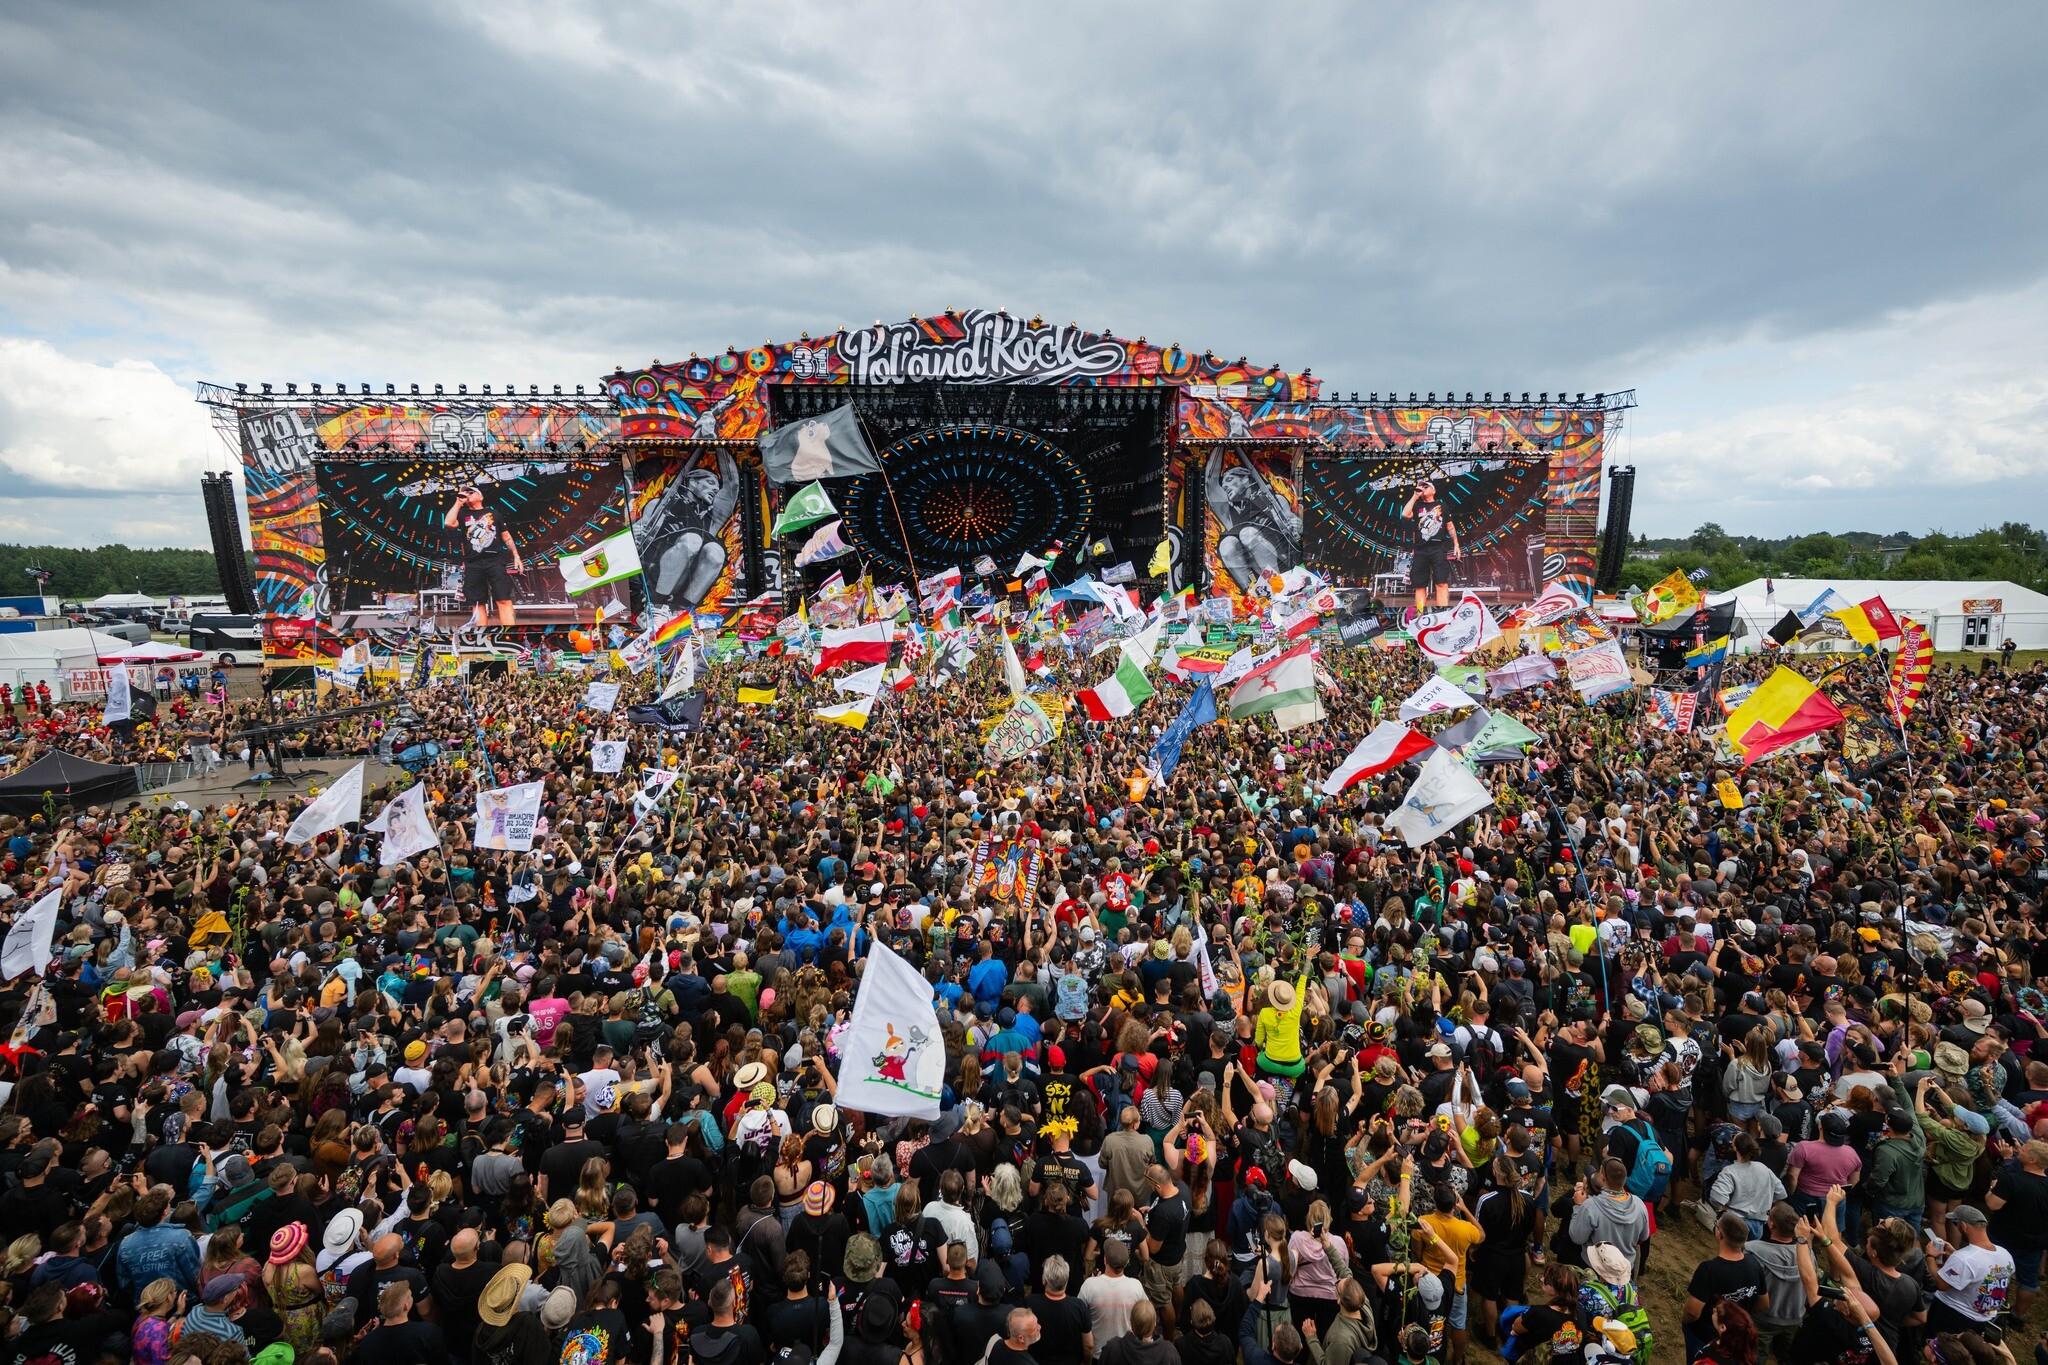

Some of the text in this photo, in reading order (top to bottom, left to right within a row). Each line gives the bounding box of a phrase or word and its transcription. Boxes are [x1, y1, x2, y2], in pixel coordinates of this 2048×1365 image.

[792, 346, 829, 378] 31
[247, 408, 315, 449] POL
[1678, 693, 1696, 732] POLSKA
[1045, 1083, 1072, 1097] SEX
[139, 1249, 169, 1263] FREE
